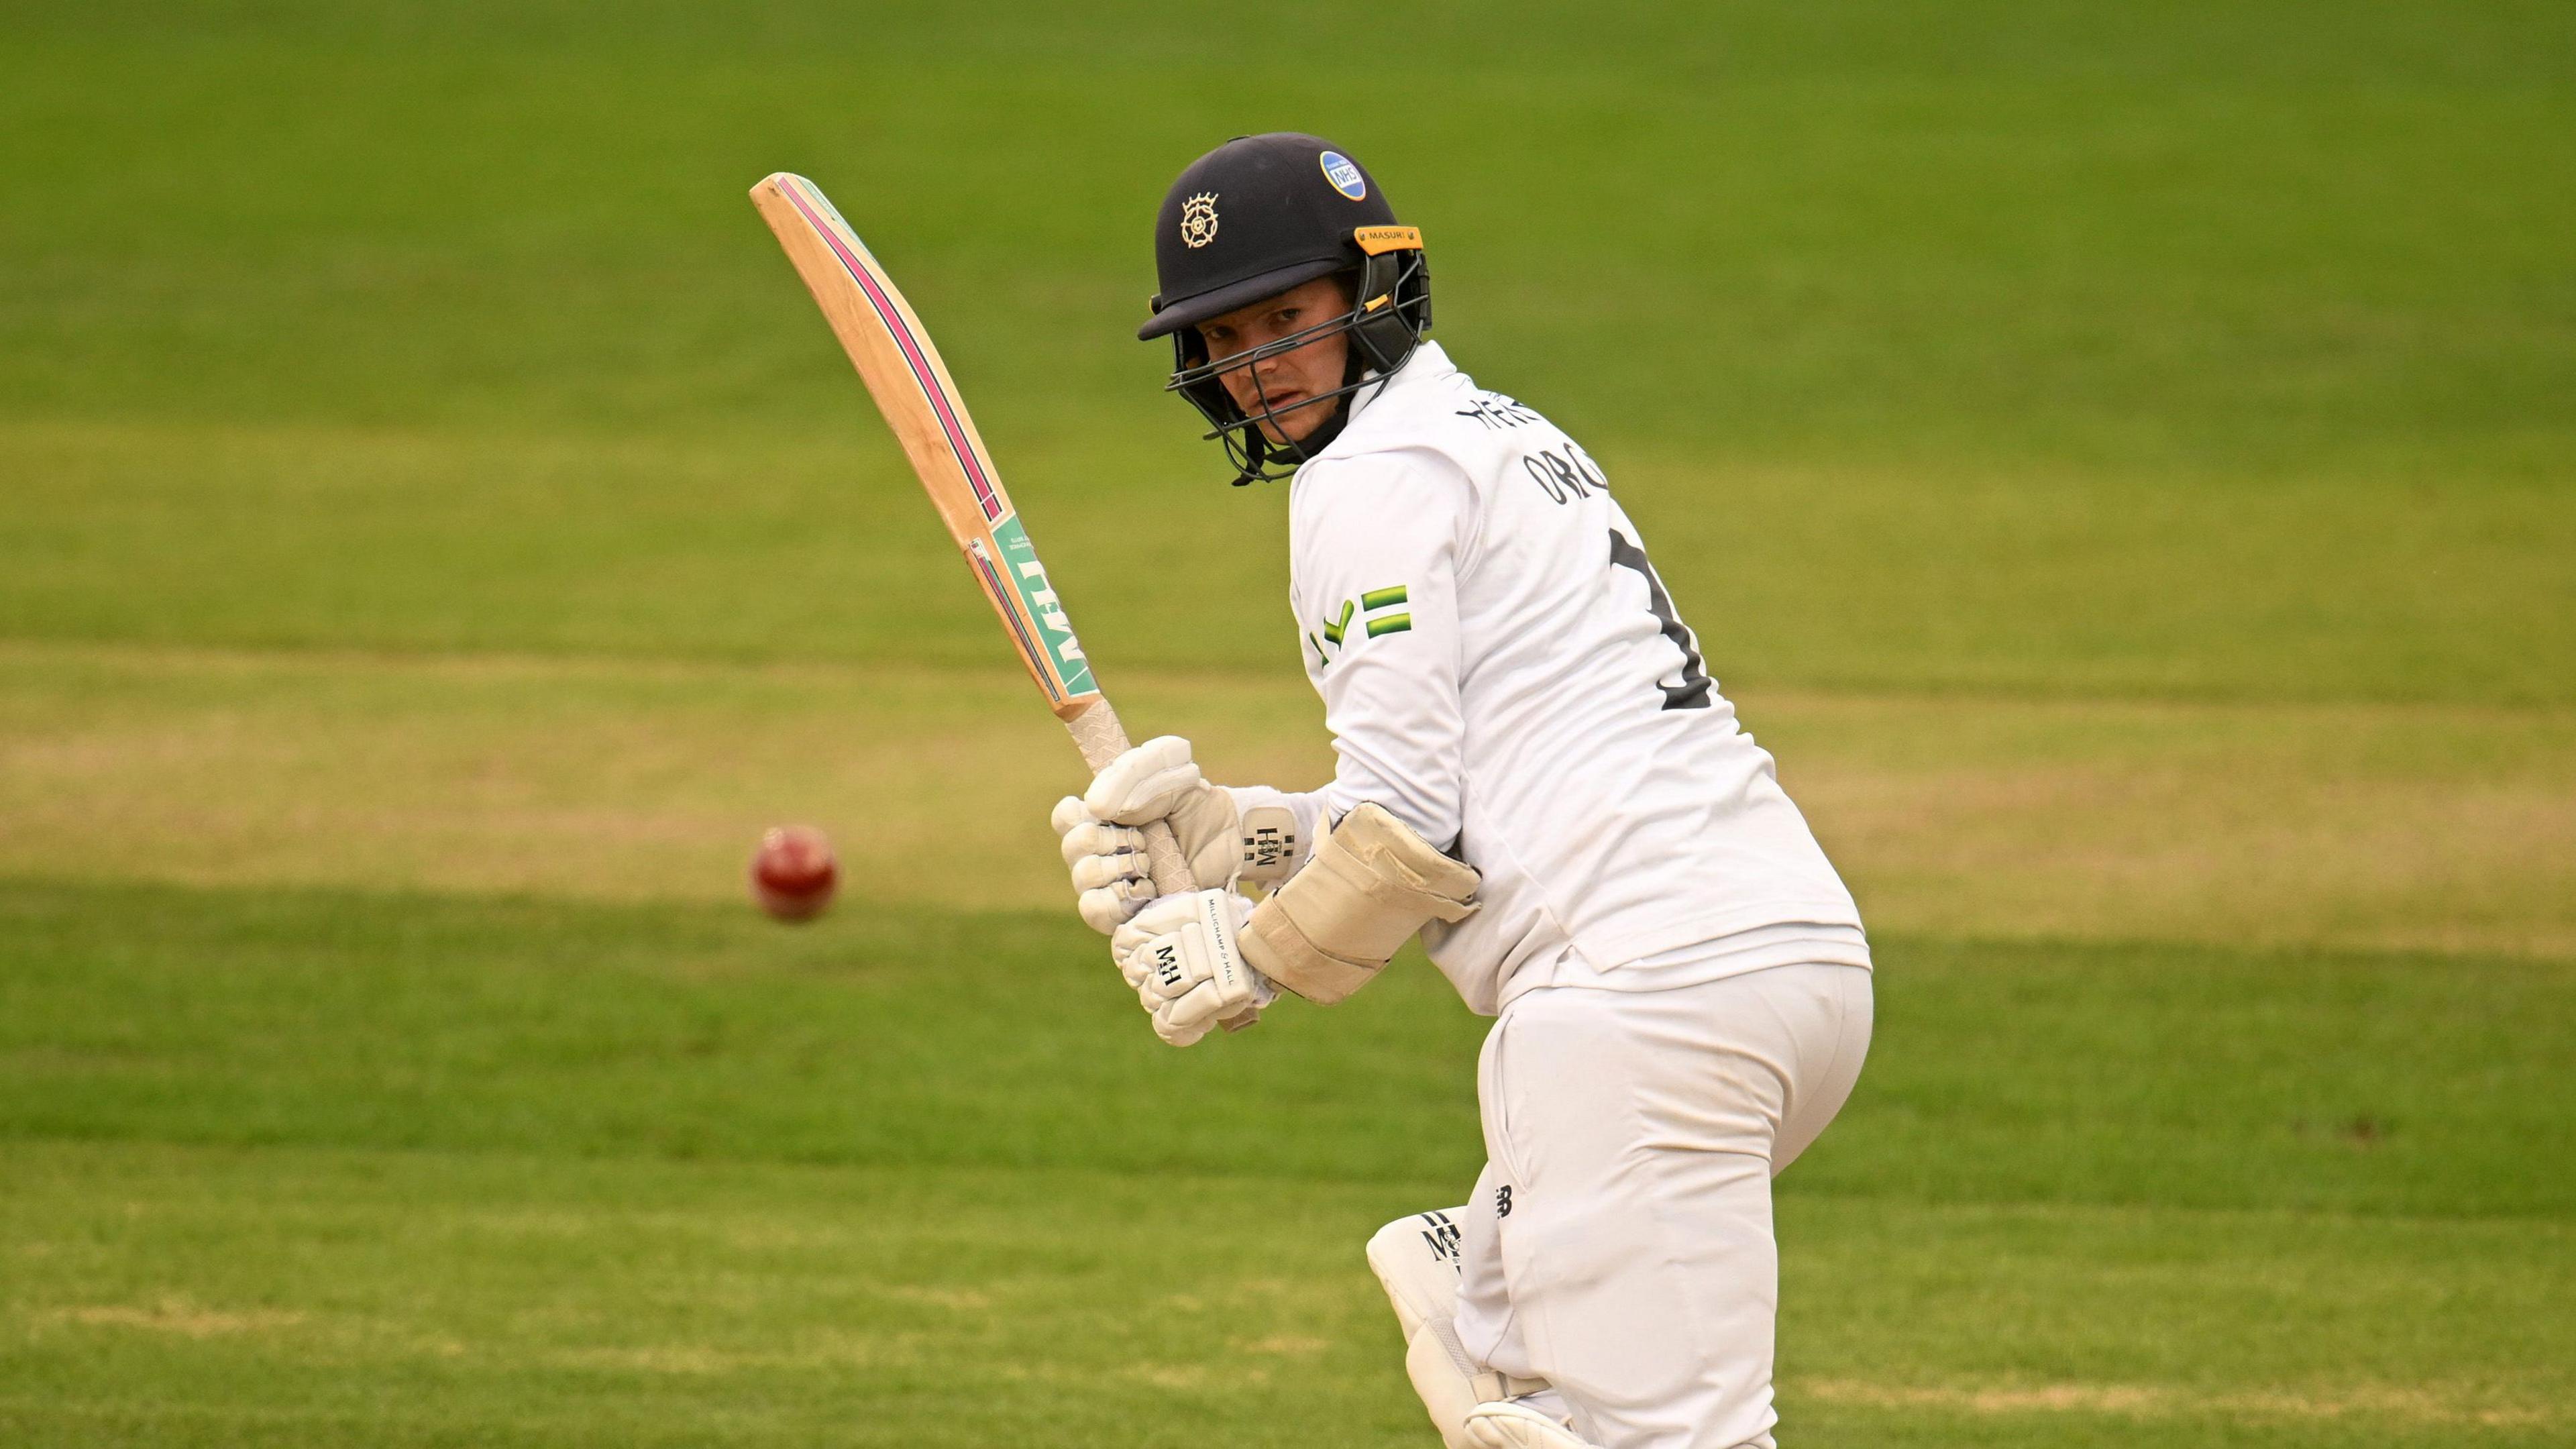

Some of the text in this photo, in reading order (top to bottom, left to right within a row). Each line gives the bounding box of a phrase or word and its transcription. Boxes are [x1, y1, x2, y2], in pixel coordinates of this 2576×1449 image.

[1334, 167, 1356, 184] NHS
[1369, 231, 1405, 239] MASURI
[1208, 899, 1225, 951] MILLICHAMP
[1224, 961, 1234, 985] HALL
